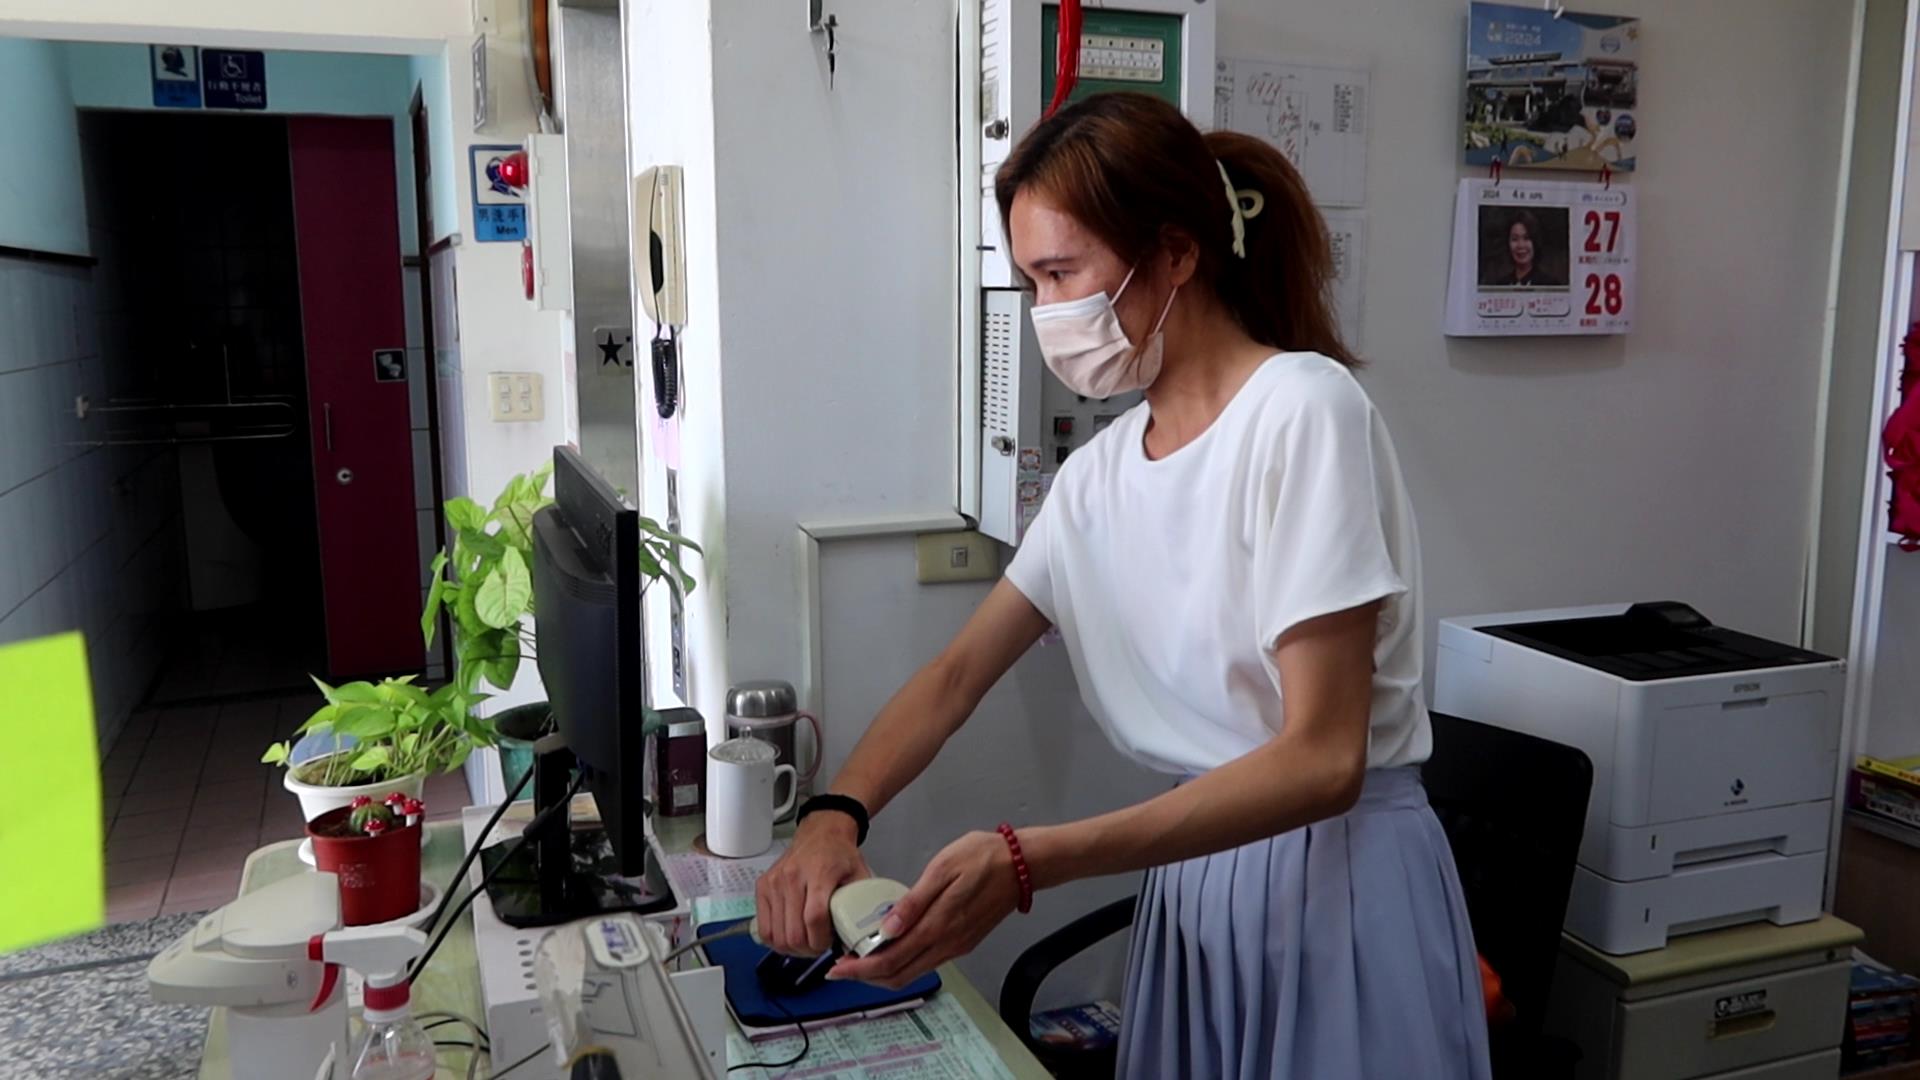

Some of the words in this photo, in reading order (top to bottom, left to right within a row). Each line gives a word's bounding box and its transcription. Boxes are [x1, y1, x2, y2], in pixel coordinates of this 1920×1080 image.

[235, 92, 262, 103] Toilet
[478, 208, 526, 222] 男洗手
[496, 225, 519, 234] Men
[1584, 210, 1620, 253] 27
[1585, 273, 1622, 316] 28
